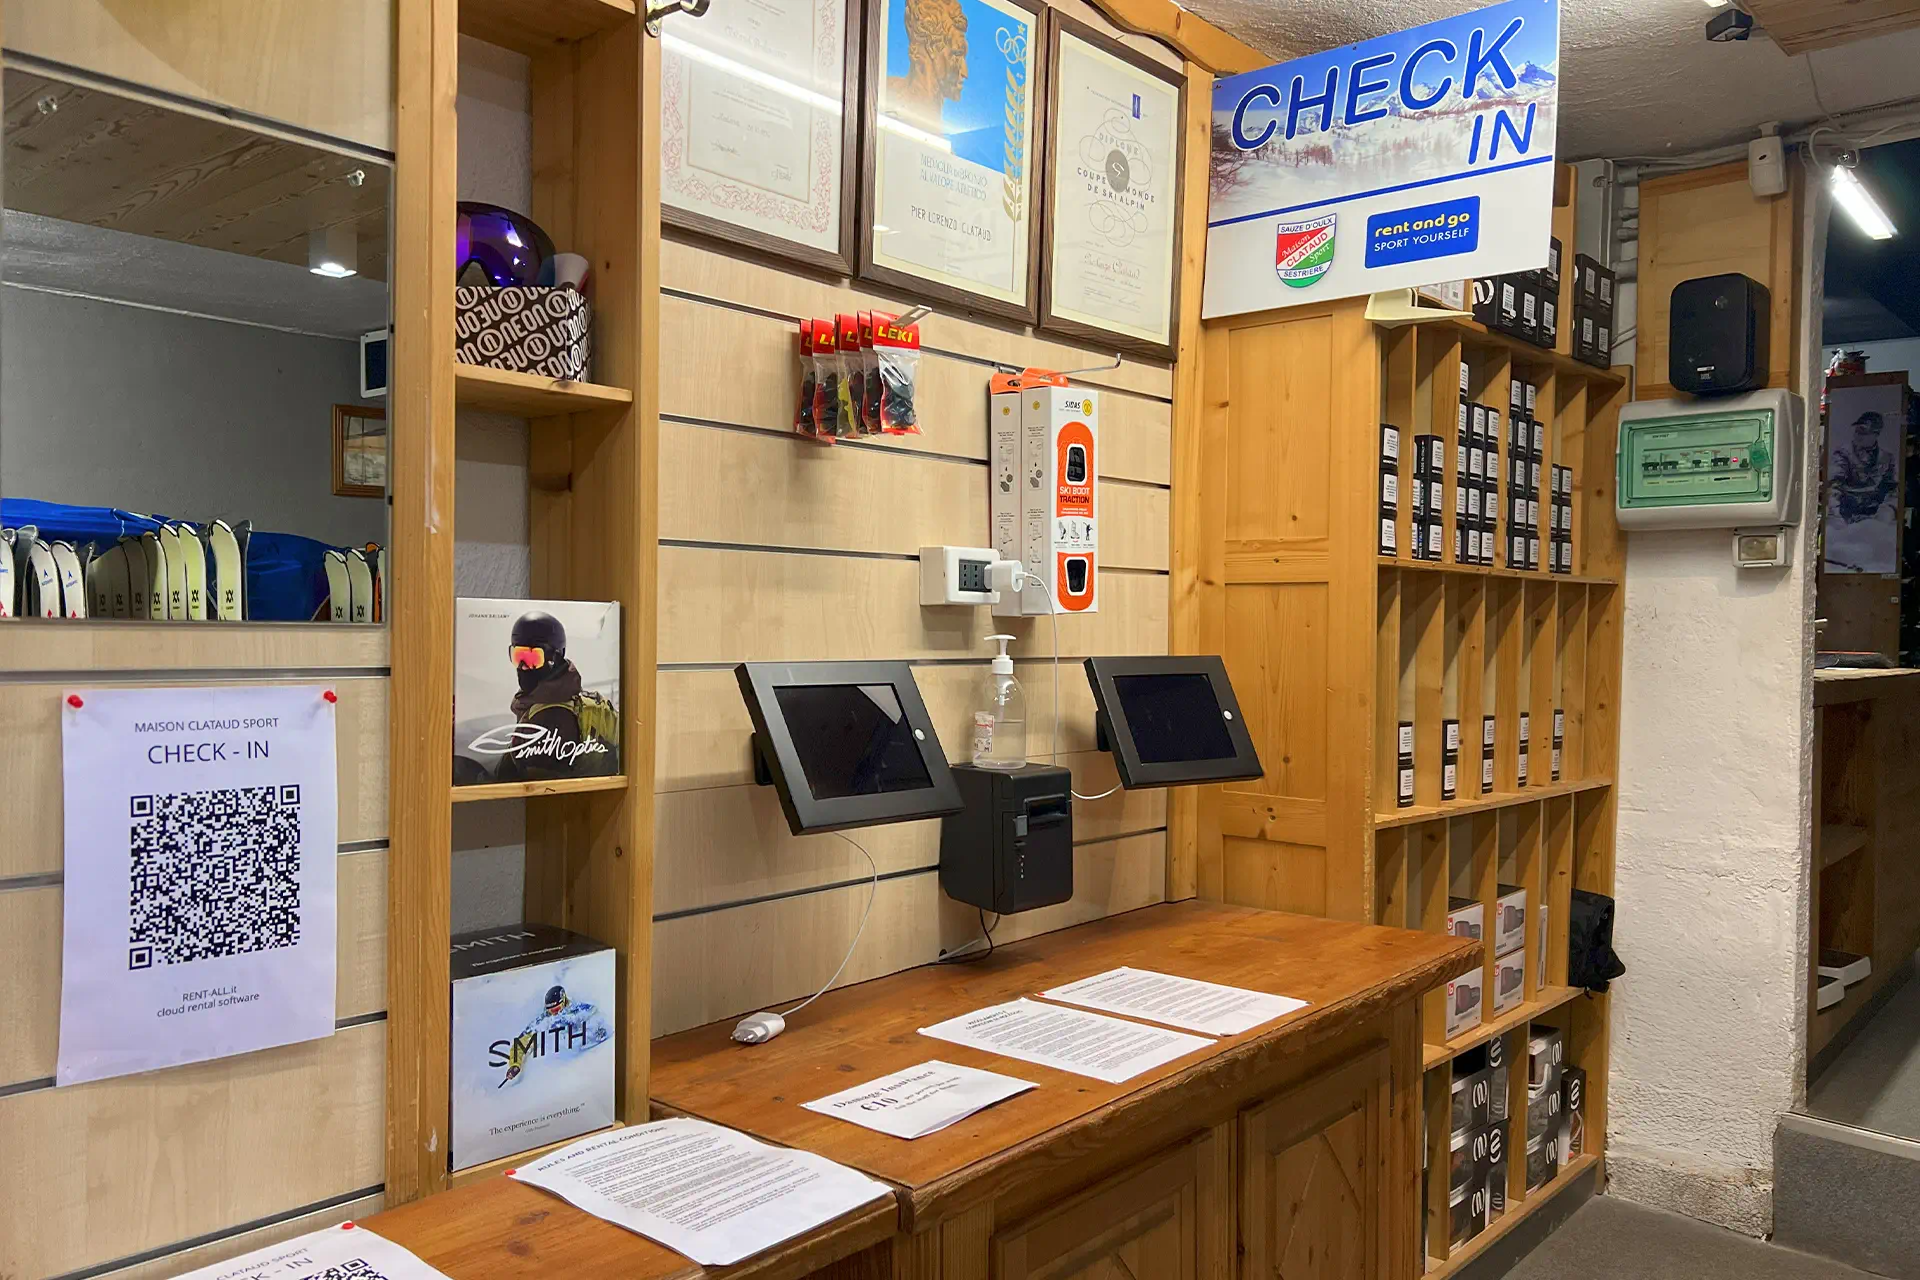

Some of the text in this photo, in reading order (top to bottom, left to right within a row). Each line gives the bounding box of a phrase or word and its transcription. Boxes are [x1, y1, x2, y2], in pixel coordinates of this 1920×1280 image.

[1232, 16, 1523, 150] CHECK
[1467, 102, 1536, 165] IN
[1076, 166, 1106, 187] COUPE
[1125, 186, 1155, 204] MONDE
[1086, 183, 1145, 212] DE SKI ALPIN
[911, 204, 926, 221] PIER
[928, 211, 958, 231] LORENZO
[961, 222, 992, 242] CLATAUD
[1280, 217, 1333, 234] SAUZE D'OULX
[1375, 212, 1470, 238] rent and go
[1281, 234, 1311, 259] Maison
[1286, 232, 1328, 267] CLATAUD
[1374, 227, 1470, 252] SPORT YOURSELF
[1308, 243, 1330, 264] Sport
[1283, 265, 1324, 278] SESTRIERE
[878, 325, 913, 343] LEKI
[1059, 486, 1090, 495] SKI BOOT
[1059, 495, 1090, 504] TRACTION
[134, 717, 279, 733] MAISON CLATAUD SPORT
[147, 742, 226, 764] CHECK
[246, 740, 270, 760] IN
[157, 991, 260, 1018] cloud rental software
[182, 985, 237, 1003] RENT-ALL.it
[488, 1021, 587, 1068] SMITH
[832, 1091, 883, 1109] Damage
[880, 1071, 936, 1093] Insurance
[860, 1097, 899, 1111] €10
[489, 1127, 504, 1136] The
[504, 1117, 539, 1133] experience
[540, 1114, 546, 1122] is
[537, 1158, 566, 1172] RULES
[567, 1151, 585, 1160] AND
[585, 1141, 619, 1153] RENTAL
[272, 1247, 308, 1263] SPORT
[285, 1257, 314, 1270] IN
